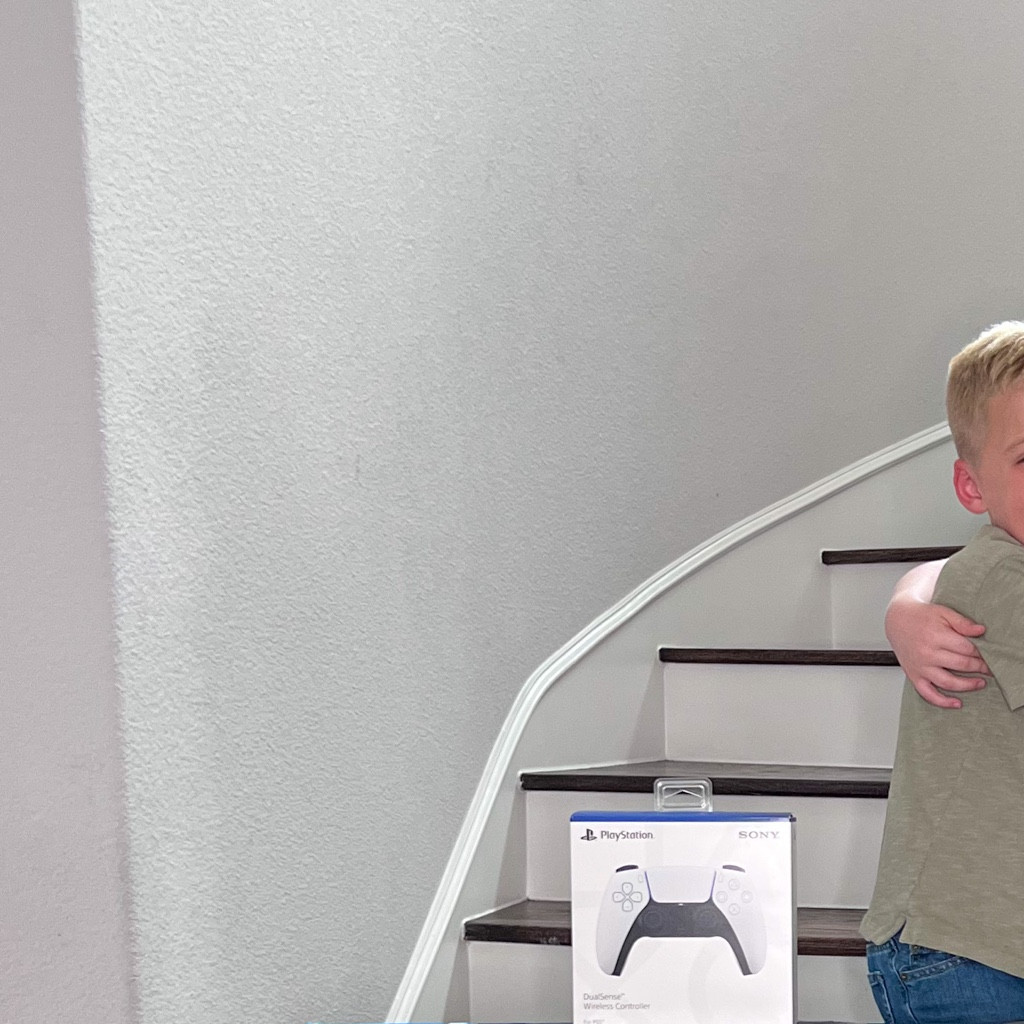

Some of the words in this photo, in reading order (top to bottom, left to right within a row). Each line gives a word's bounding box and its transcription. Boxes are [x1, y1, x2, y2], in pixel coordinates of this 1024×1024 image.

[601, 830, 654, 841] PlayStation
[738, 831, 780, 839] SONY
[583, 1002, 614, 1010] Wireless
[615, 1002, 651, 1010] Controller
